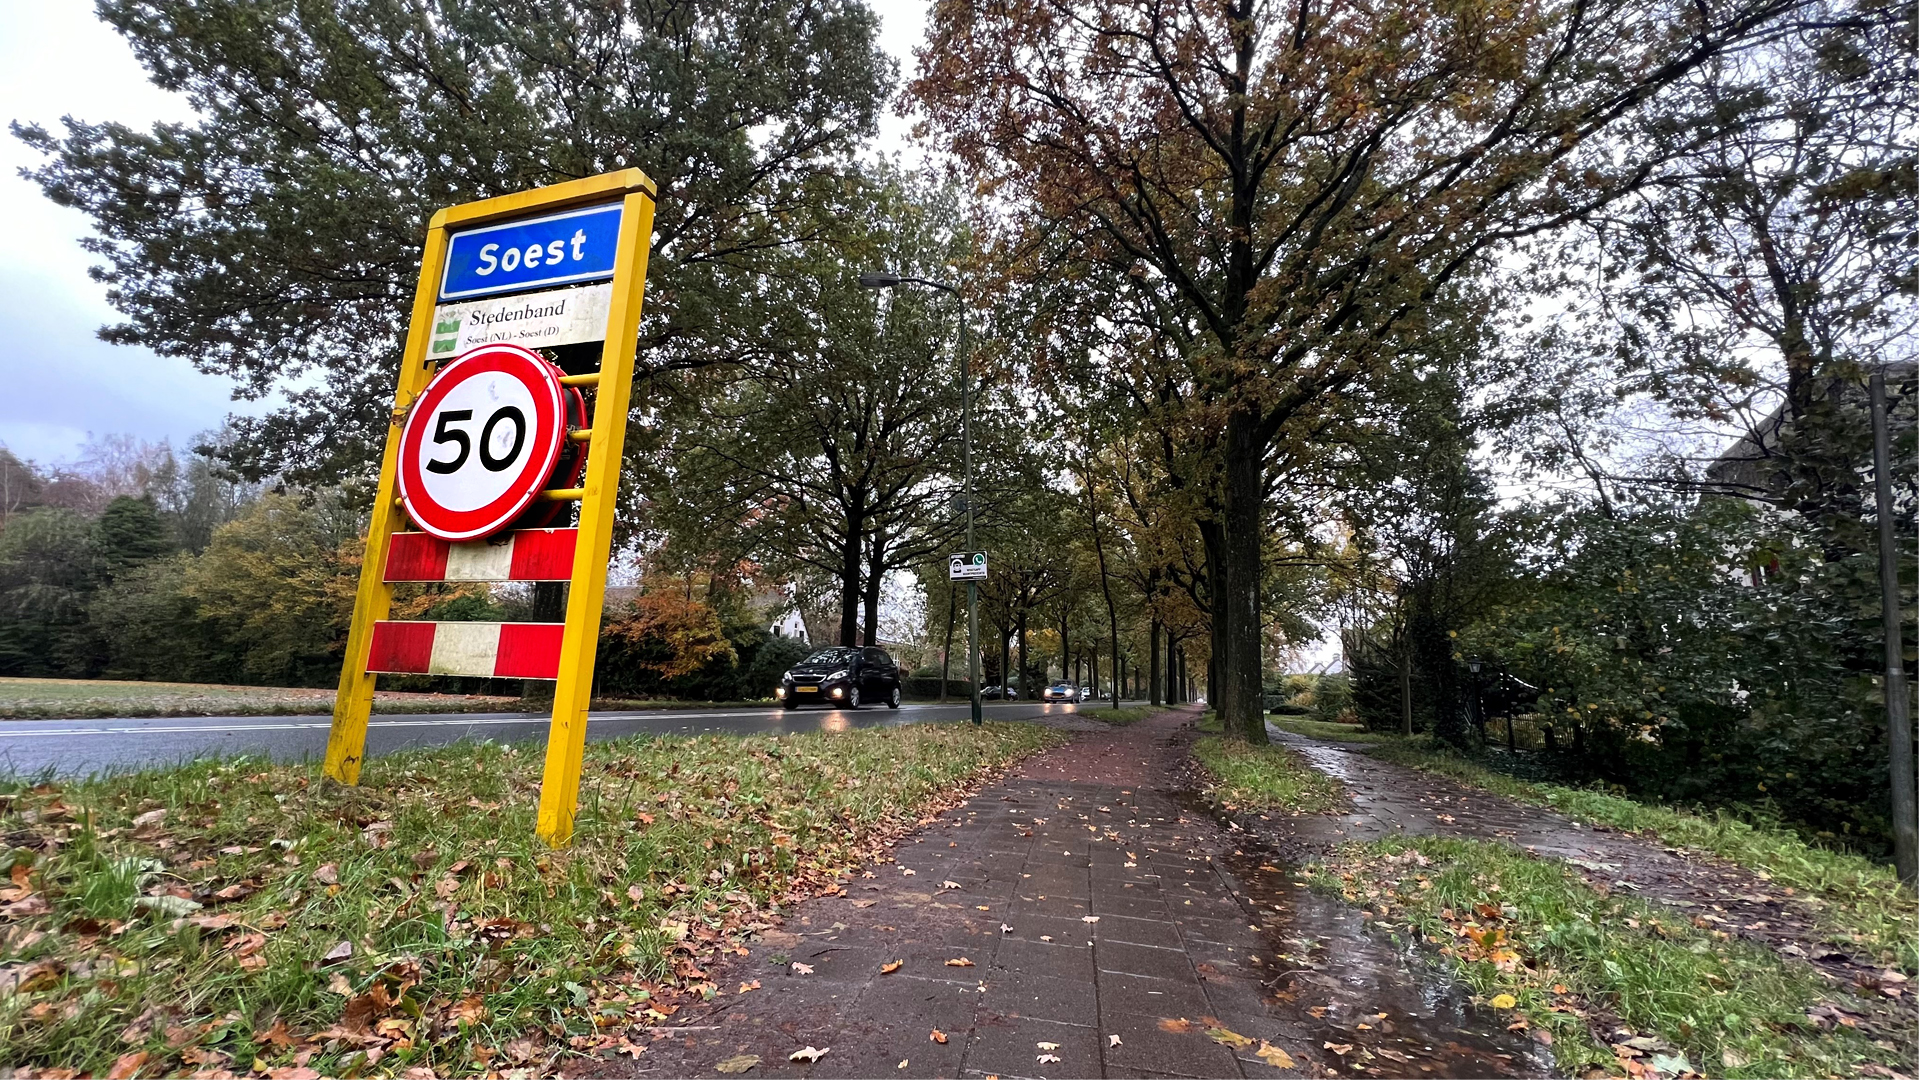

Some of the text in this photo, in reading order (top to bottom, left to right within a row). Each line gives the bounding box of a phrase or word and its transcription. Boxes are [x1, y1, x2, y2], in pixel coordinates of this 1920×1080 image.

[475, 229, 586, 276] Soest
[470, 299, 566, 326] Stedenband
[466, 335, 488, 345] Soest
[490, 331, 512, 343] (NL)
[519, 329, 542, 339] Soest
[543, 326, 560, 337] (D)
[426, 406, 526, 475] 50
